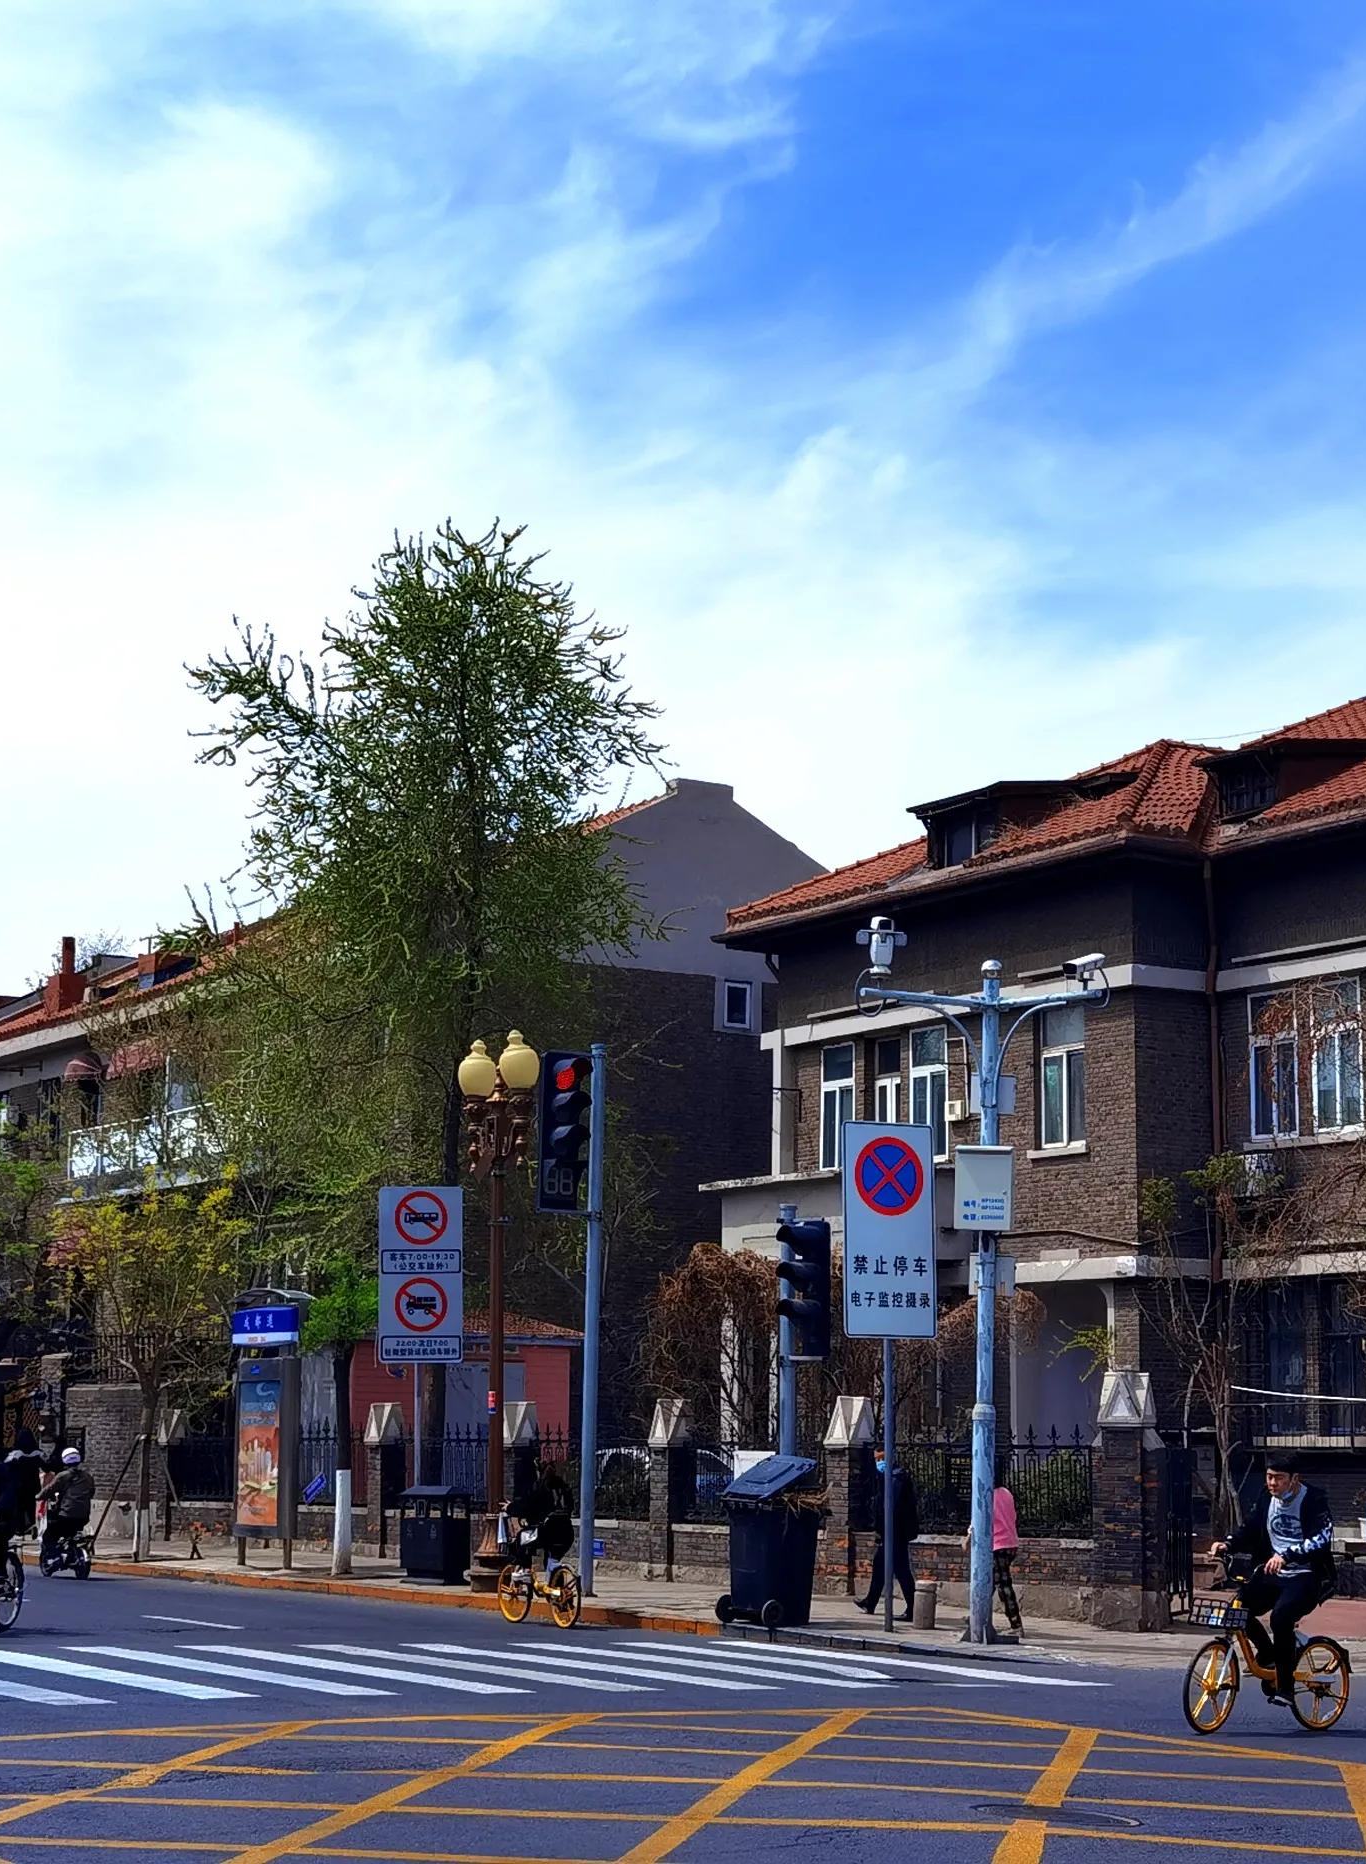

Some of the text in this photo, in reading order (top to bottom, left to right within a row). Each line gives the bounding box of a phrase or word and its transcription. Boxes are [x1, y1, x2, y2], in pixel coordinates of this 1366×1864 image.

[853, 1254, 928, 1277] 禁止停车
[850, 1290, 931, 1309] 电子监控摄录
